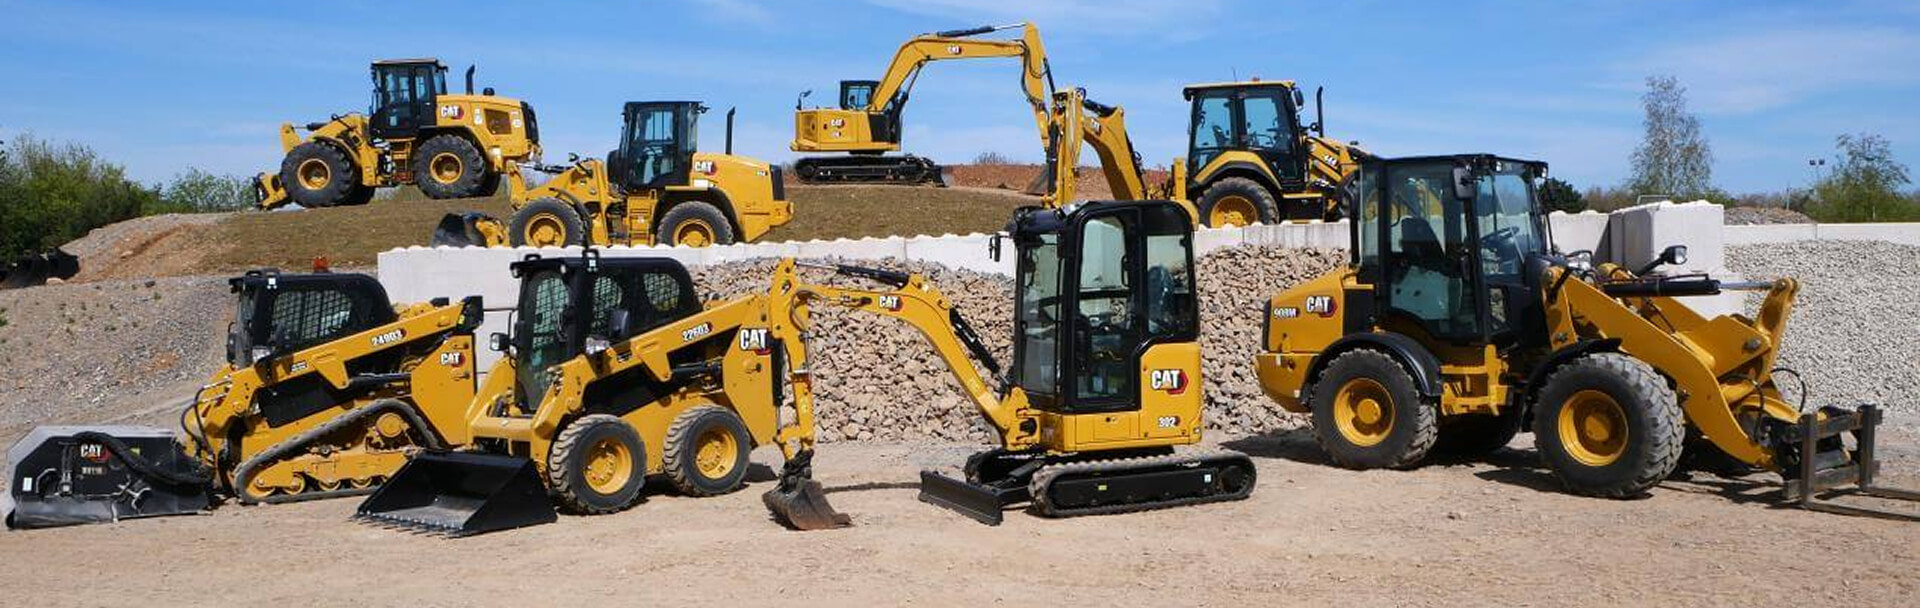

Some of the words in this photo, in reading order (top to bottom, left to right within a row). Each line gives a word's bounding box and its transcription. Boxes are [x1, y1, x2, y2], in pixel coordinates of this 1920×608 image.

[441, 104, 459, 117] CAT
[694, 160, 712, 173] CAT
[879, 296, 897, 309] CAT
[1306, 296, 1330, 313] CAT
[740, 328, 767, 351] CAT
[440, 352, 461, 366] CAT
[1150, 370, 1180, 390] CAT
[1158, 416, 1176, 427] 302
[80, 443, 103, 458] CAT
